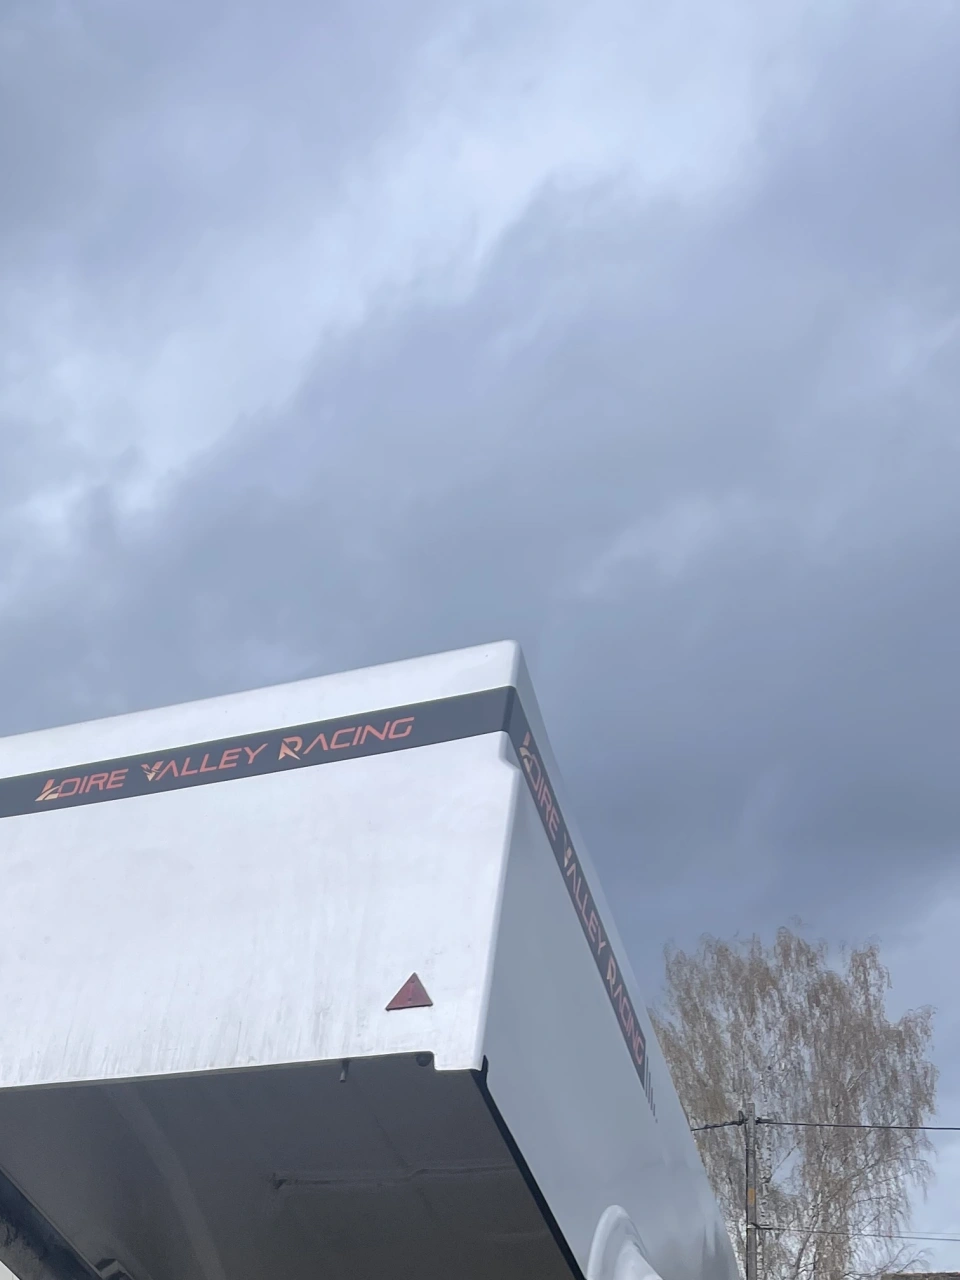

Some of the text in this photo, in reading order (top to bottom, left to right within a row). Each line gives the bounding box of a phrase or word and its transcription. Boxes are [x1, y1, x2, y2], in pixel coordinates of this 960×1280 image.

[35, 716, 416, 802] LOIRE VALLEY RACING
